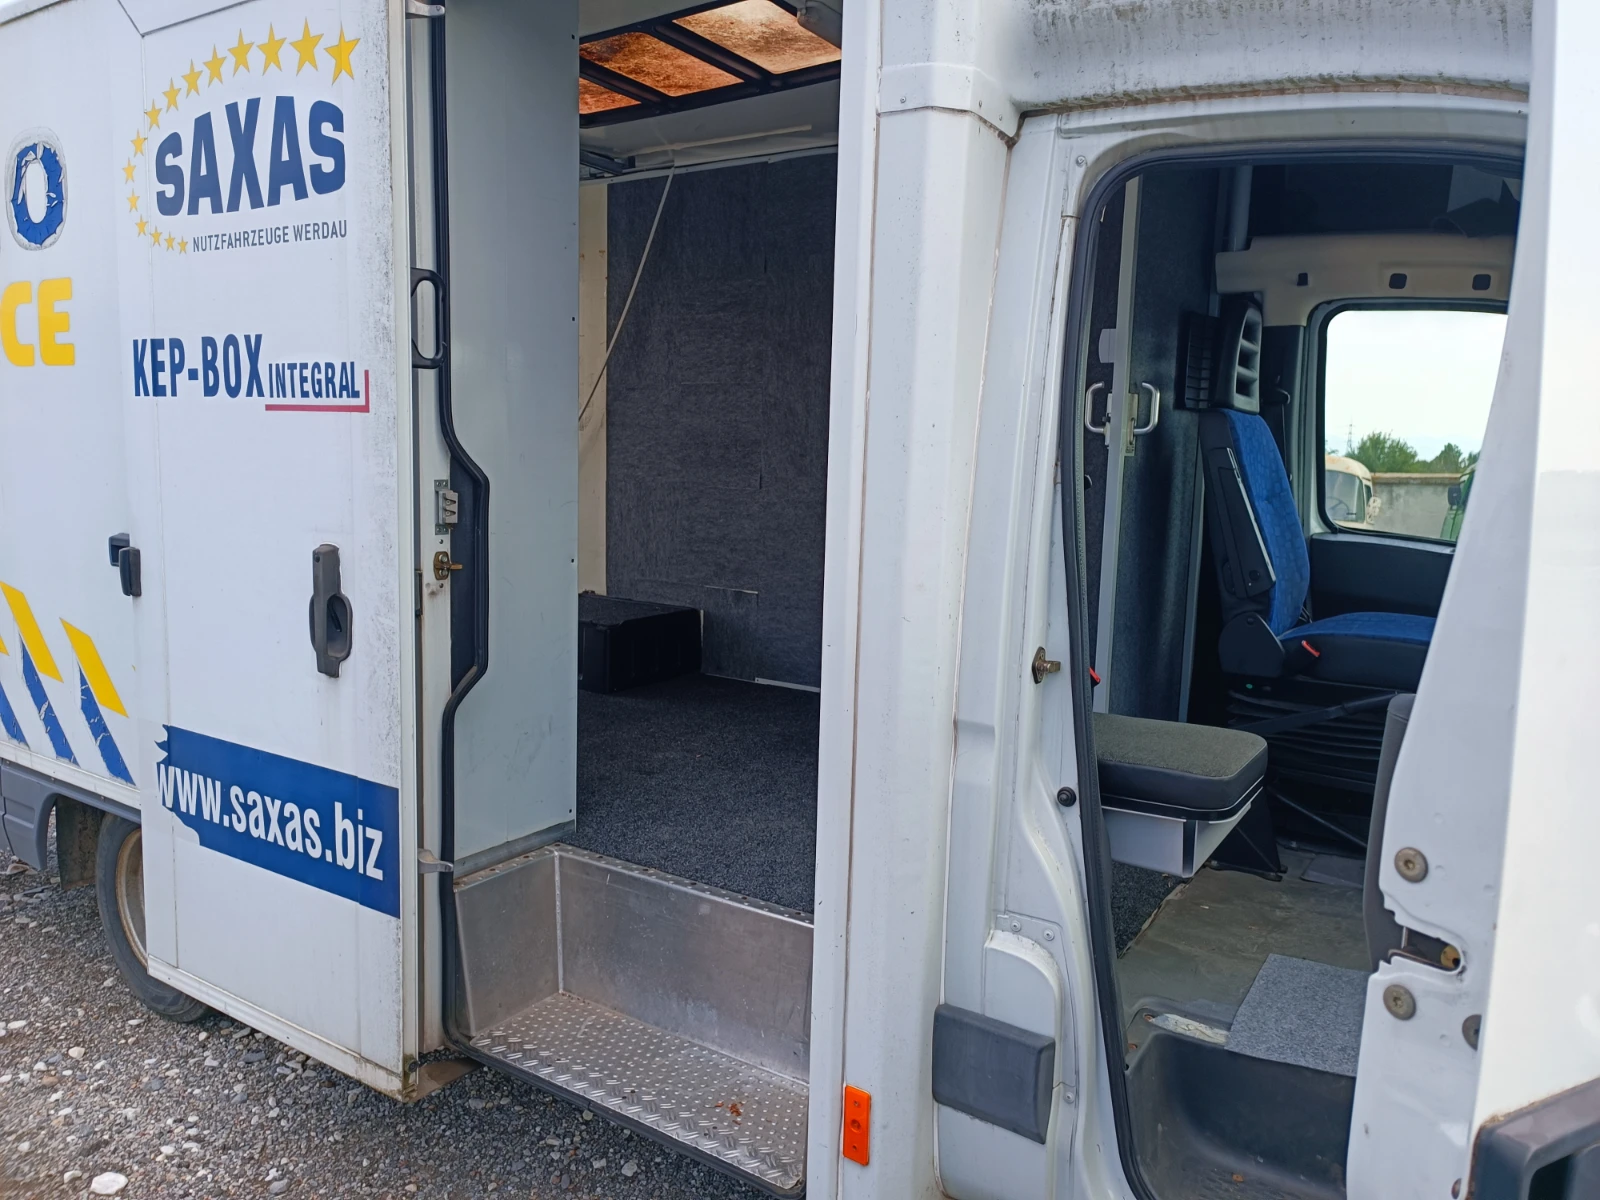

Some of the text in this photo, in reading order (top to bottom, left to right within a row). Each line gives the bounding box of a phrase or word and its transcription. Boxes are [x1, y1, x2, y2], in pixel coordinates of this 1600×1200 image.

[155, 95, 346, 217] SAXAS
[192, 219, 348, 253] NUTZFAHRZEUGE WERDAU
[132, 333, 360, 399] KEP-BOX INTEGRAL
[156, 763, 384, 880] www.saxas.biz
